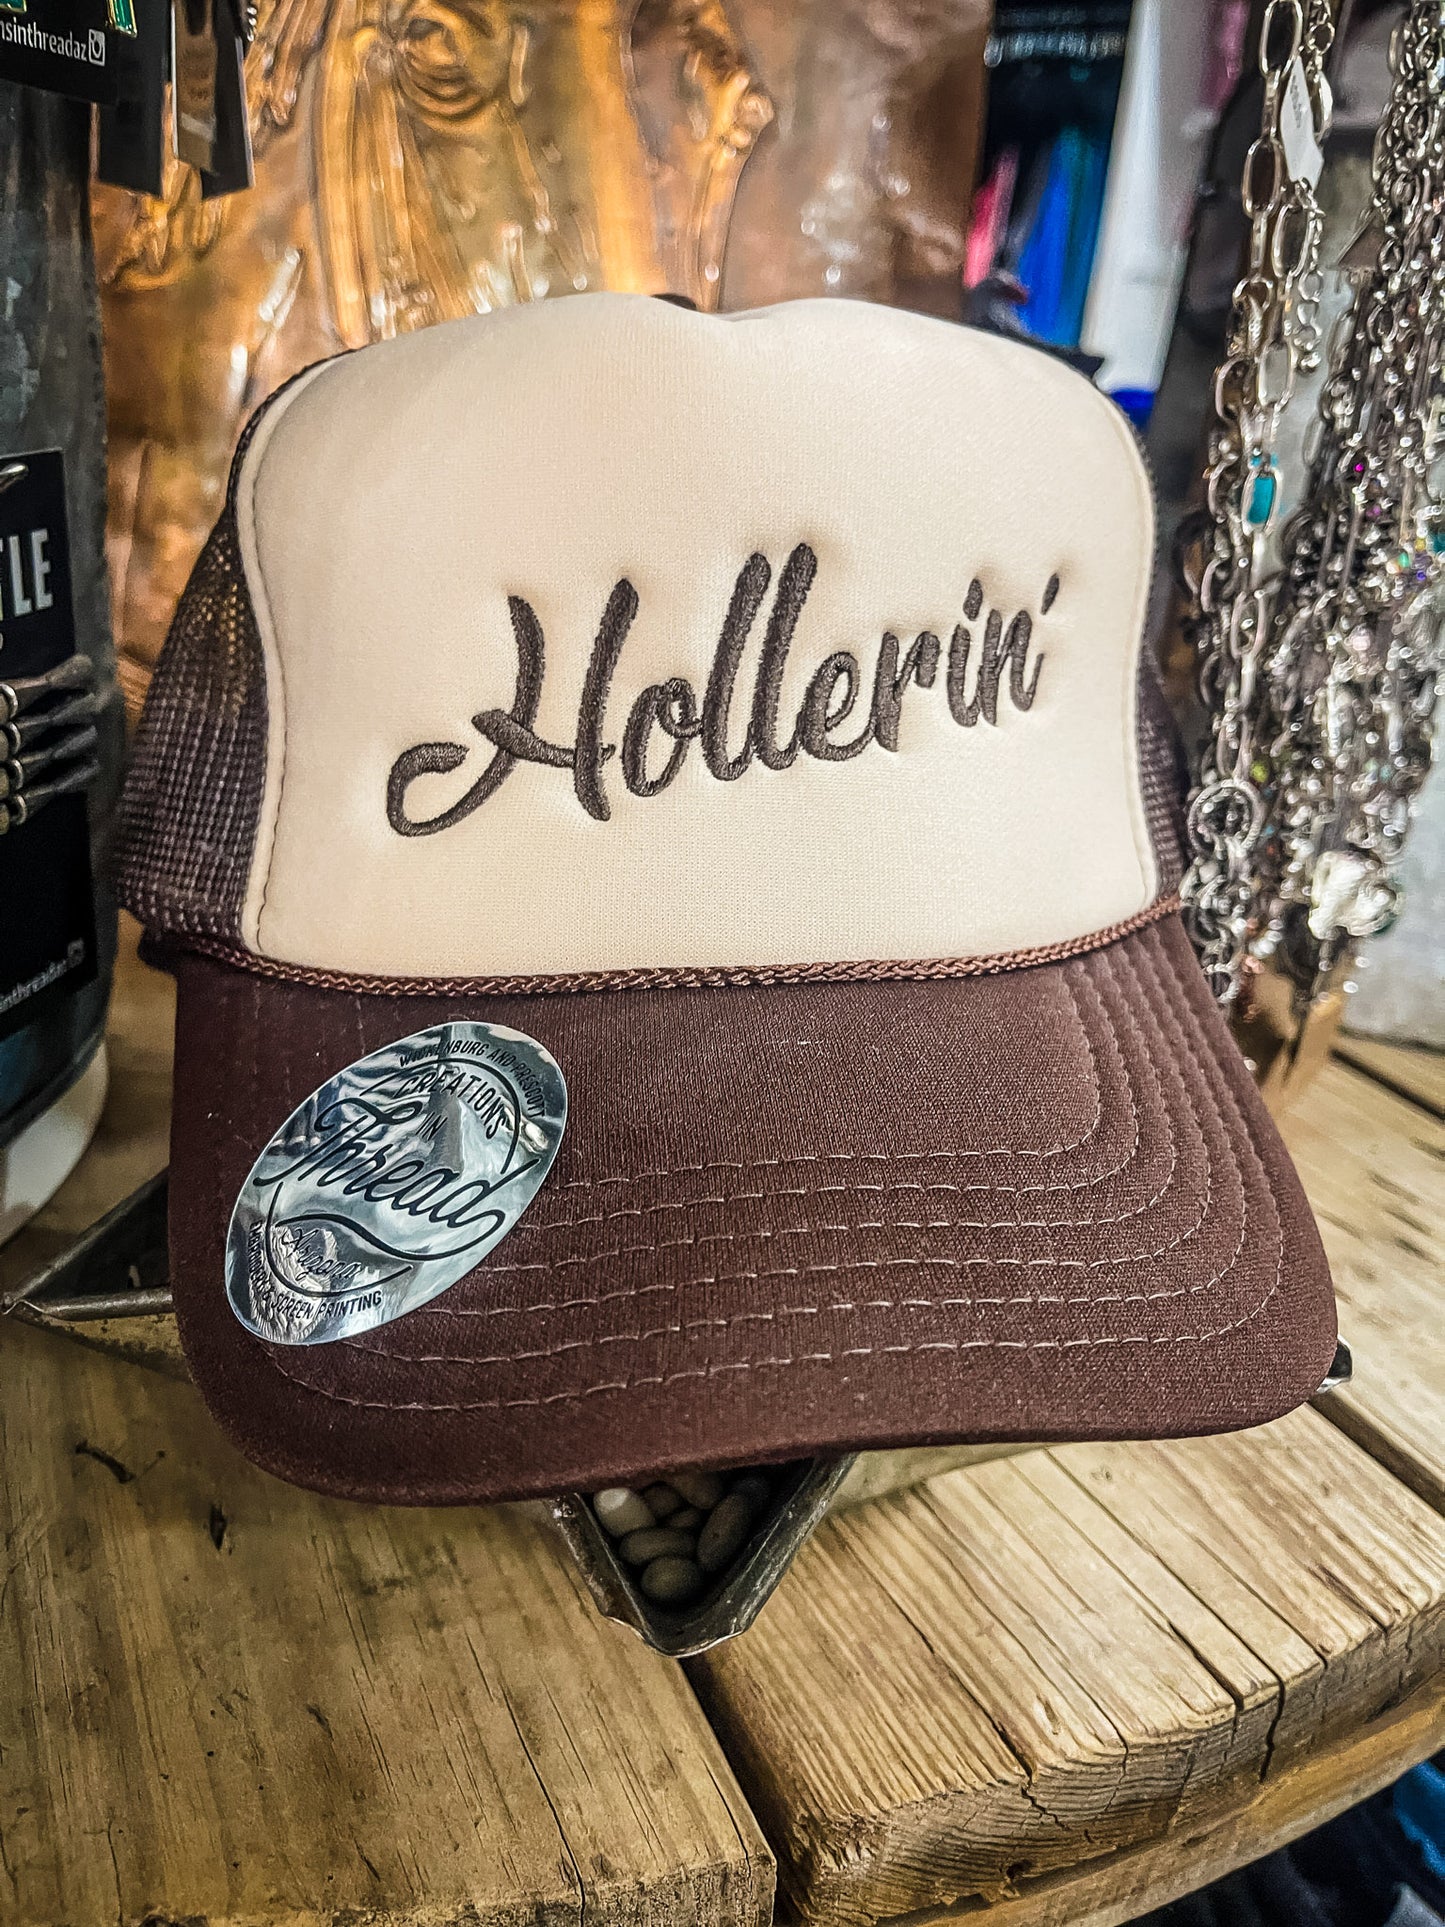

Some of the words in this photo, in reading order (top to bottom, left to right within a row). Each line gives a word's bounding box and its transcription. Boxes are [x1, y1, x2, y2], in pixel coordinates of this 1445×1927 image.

[0, 528, 54, 617] LE
[387, 543, 1060, 837] Hollerin'
[394, 1066, 507, 1140] CREATIONS
[486, 1048, 516, 1068] AND
[510, 1059, 546, 1119] PRESCOTT
[415, 1112, 448, 1141] IN
[252, 1097, 540, 1236] Thread
[281, 1227, 362, 1281] Arizona
[270, 1293, 315, 1320] SCREEN
[317, 1291, 382, 1318] PRINTING
